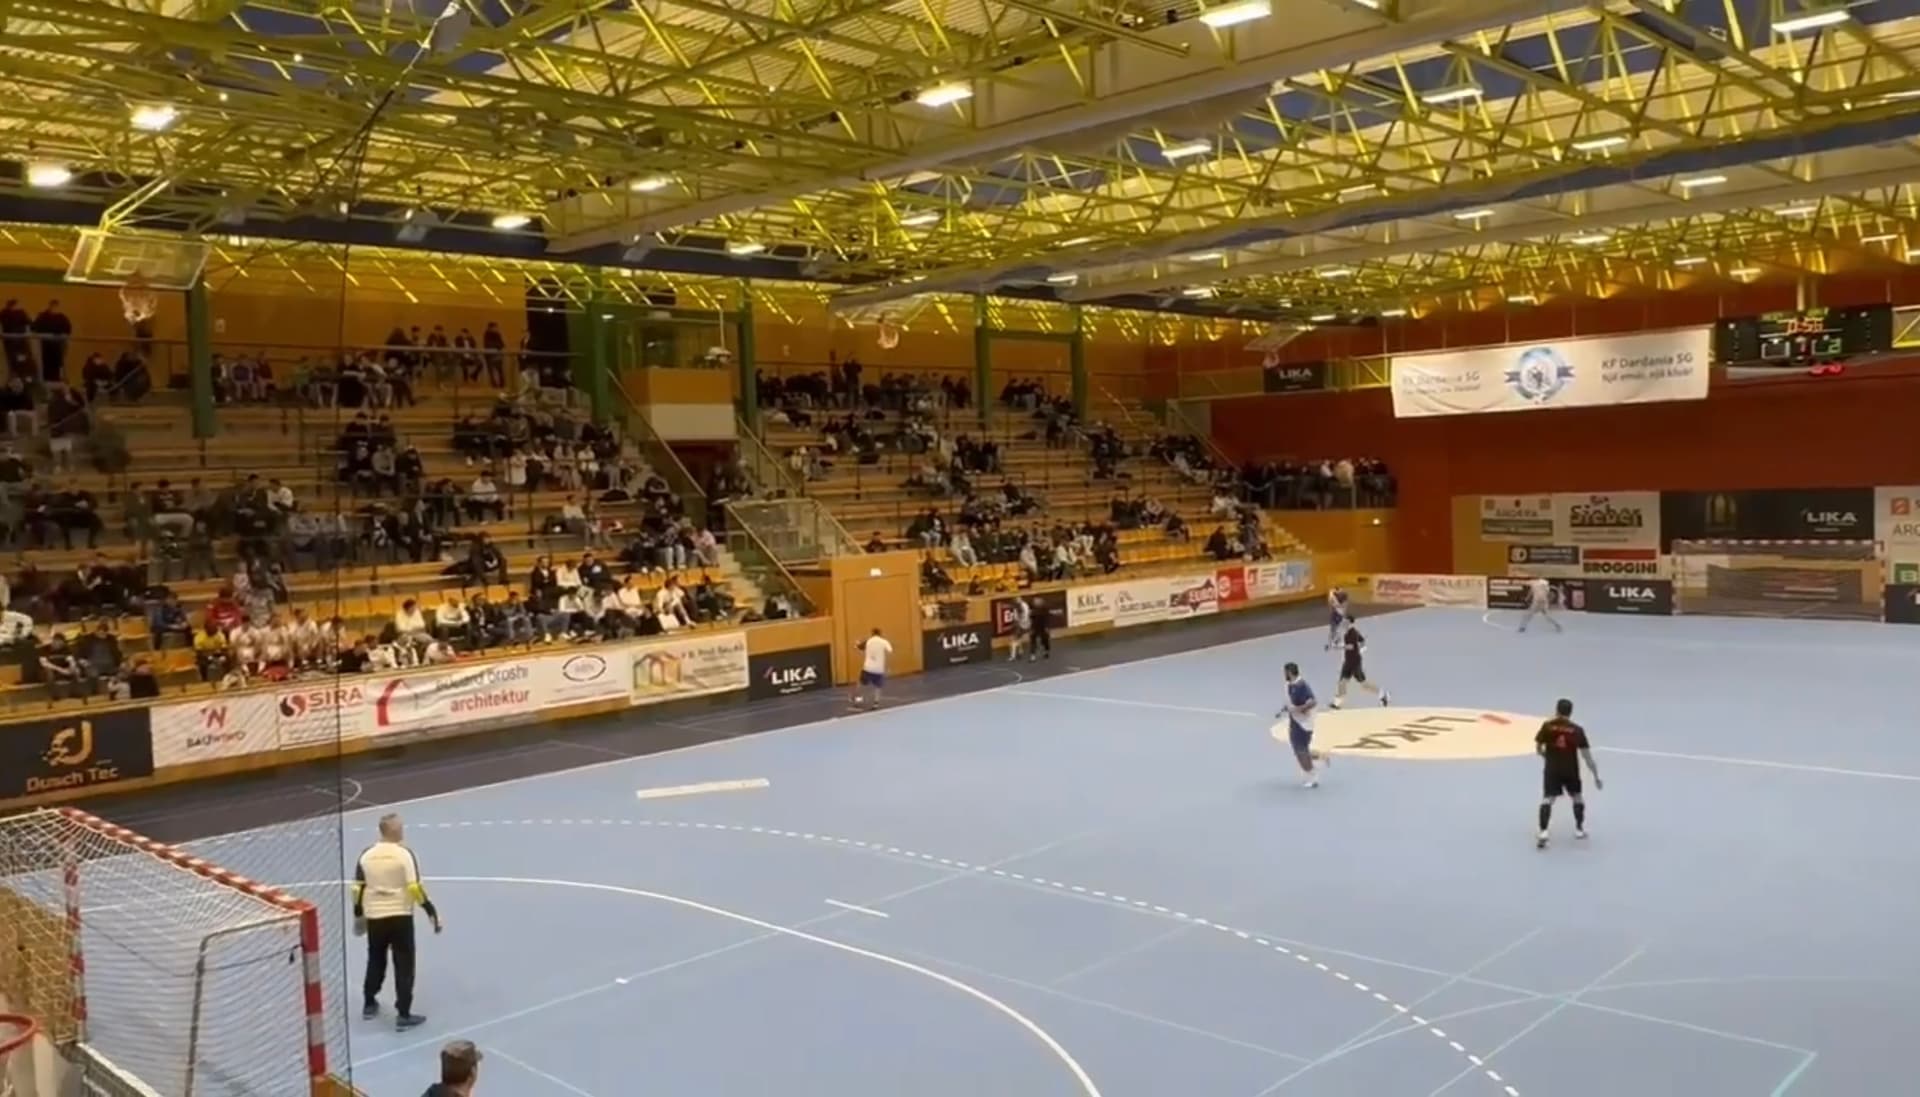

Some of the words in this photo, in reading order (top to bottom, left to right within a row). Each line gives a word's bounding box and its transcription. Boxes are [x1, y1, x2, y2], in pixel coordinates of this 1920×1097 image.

[1807, 511, 1857, 523] LIKA
[1583, 562, 1657, 574] BROGGINI
[1609, 586, 1656, 599] LIKA
[942, 632, 979, 649] LIKA
[770, 666, 817, 685] LIKA
[308, 687, 363, 705] SIRA
[449, 688, 531, 713] architektur
[26, 771, 84, 792] Dusch
